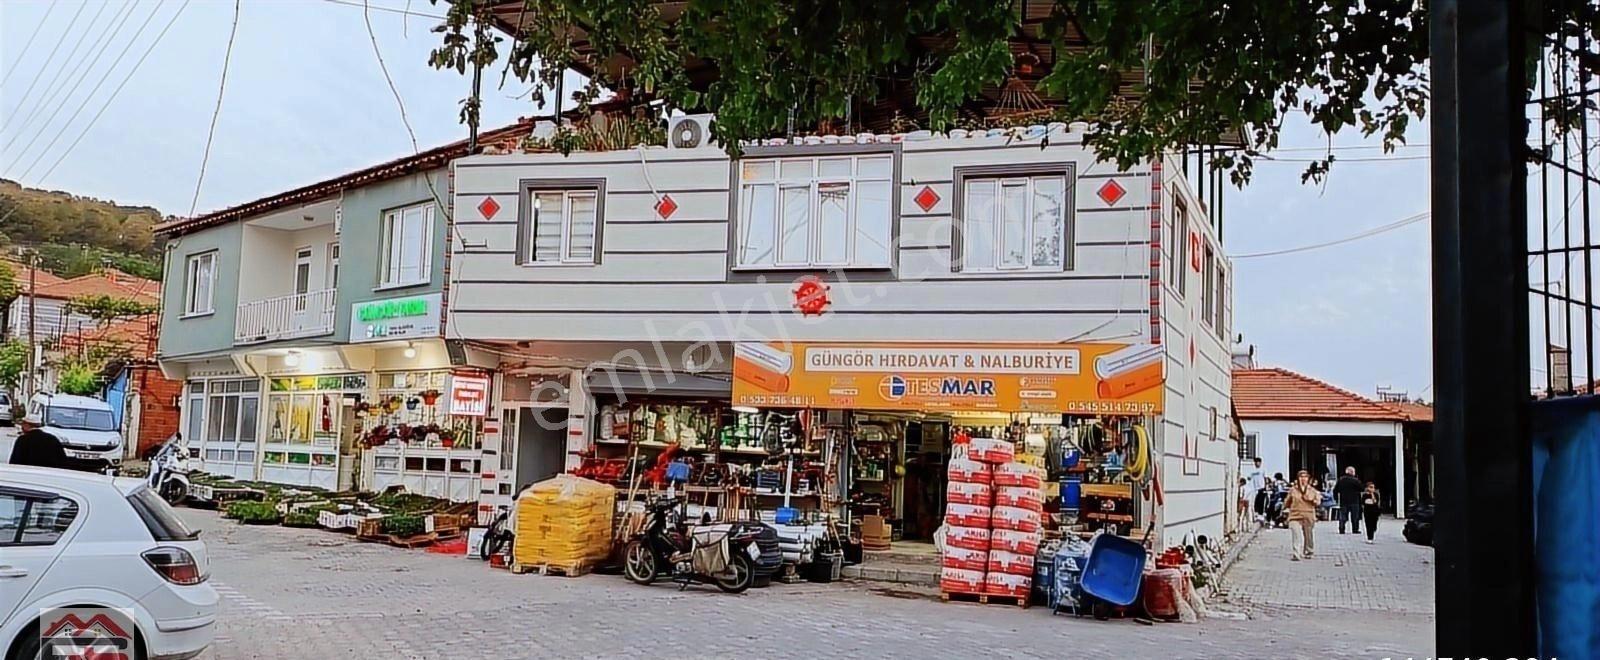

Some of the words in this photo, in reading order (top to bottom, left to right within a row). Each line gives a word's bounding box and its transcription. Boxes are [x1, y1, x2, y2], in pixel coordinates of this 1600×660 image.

[811, 350, 873, 367] GÜNGÖR
[880, 354, 958, 368] HIRDAVAT
[964, 355, 974, 367] &
[980, 352, 1072, 369] NALBURİYE
[906, 377, 996, 397] TESMAR
[1068, 401, 1075, 411] 0
